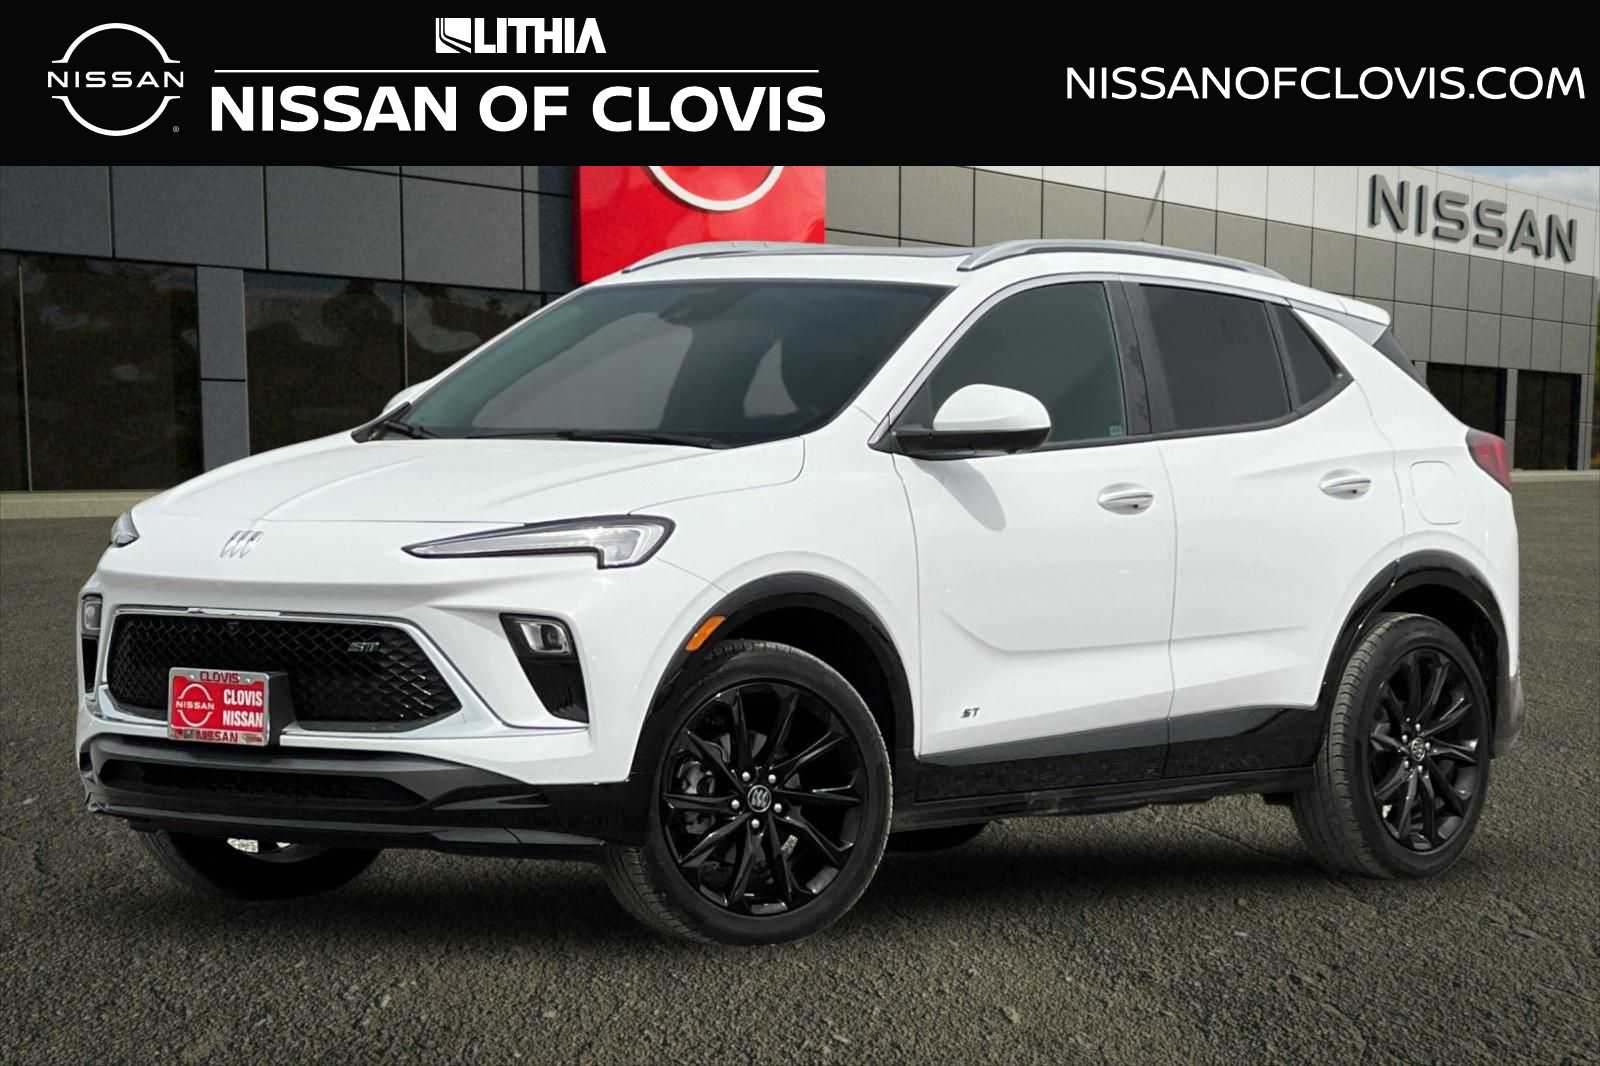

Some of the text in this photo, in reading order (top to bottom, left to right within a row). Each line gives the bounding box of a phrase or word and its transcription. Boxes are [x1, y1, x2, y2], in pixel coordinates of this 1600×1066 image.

[1368, 173, 1577, 263] NISSAN
[200, 671, 240, 684] CLOVIS
[223, 689, 263, 707] CLOVIS
[176, 701, 215, 711] NISSAN
[960, 707, 980, 719] ST
[222, 710, 264, 728] NISSAN
